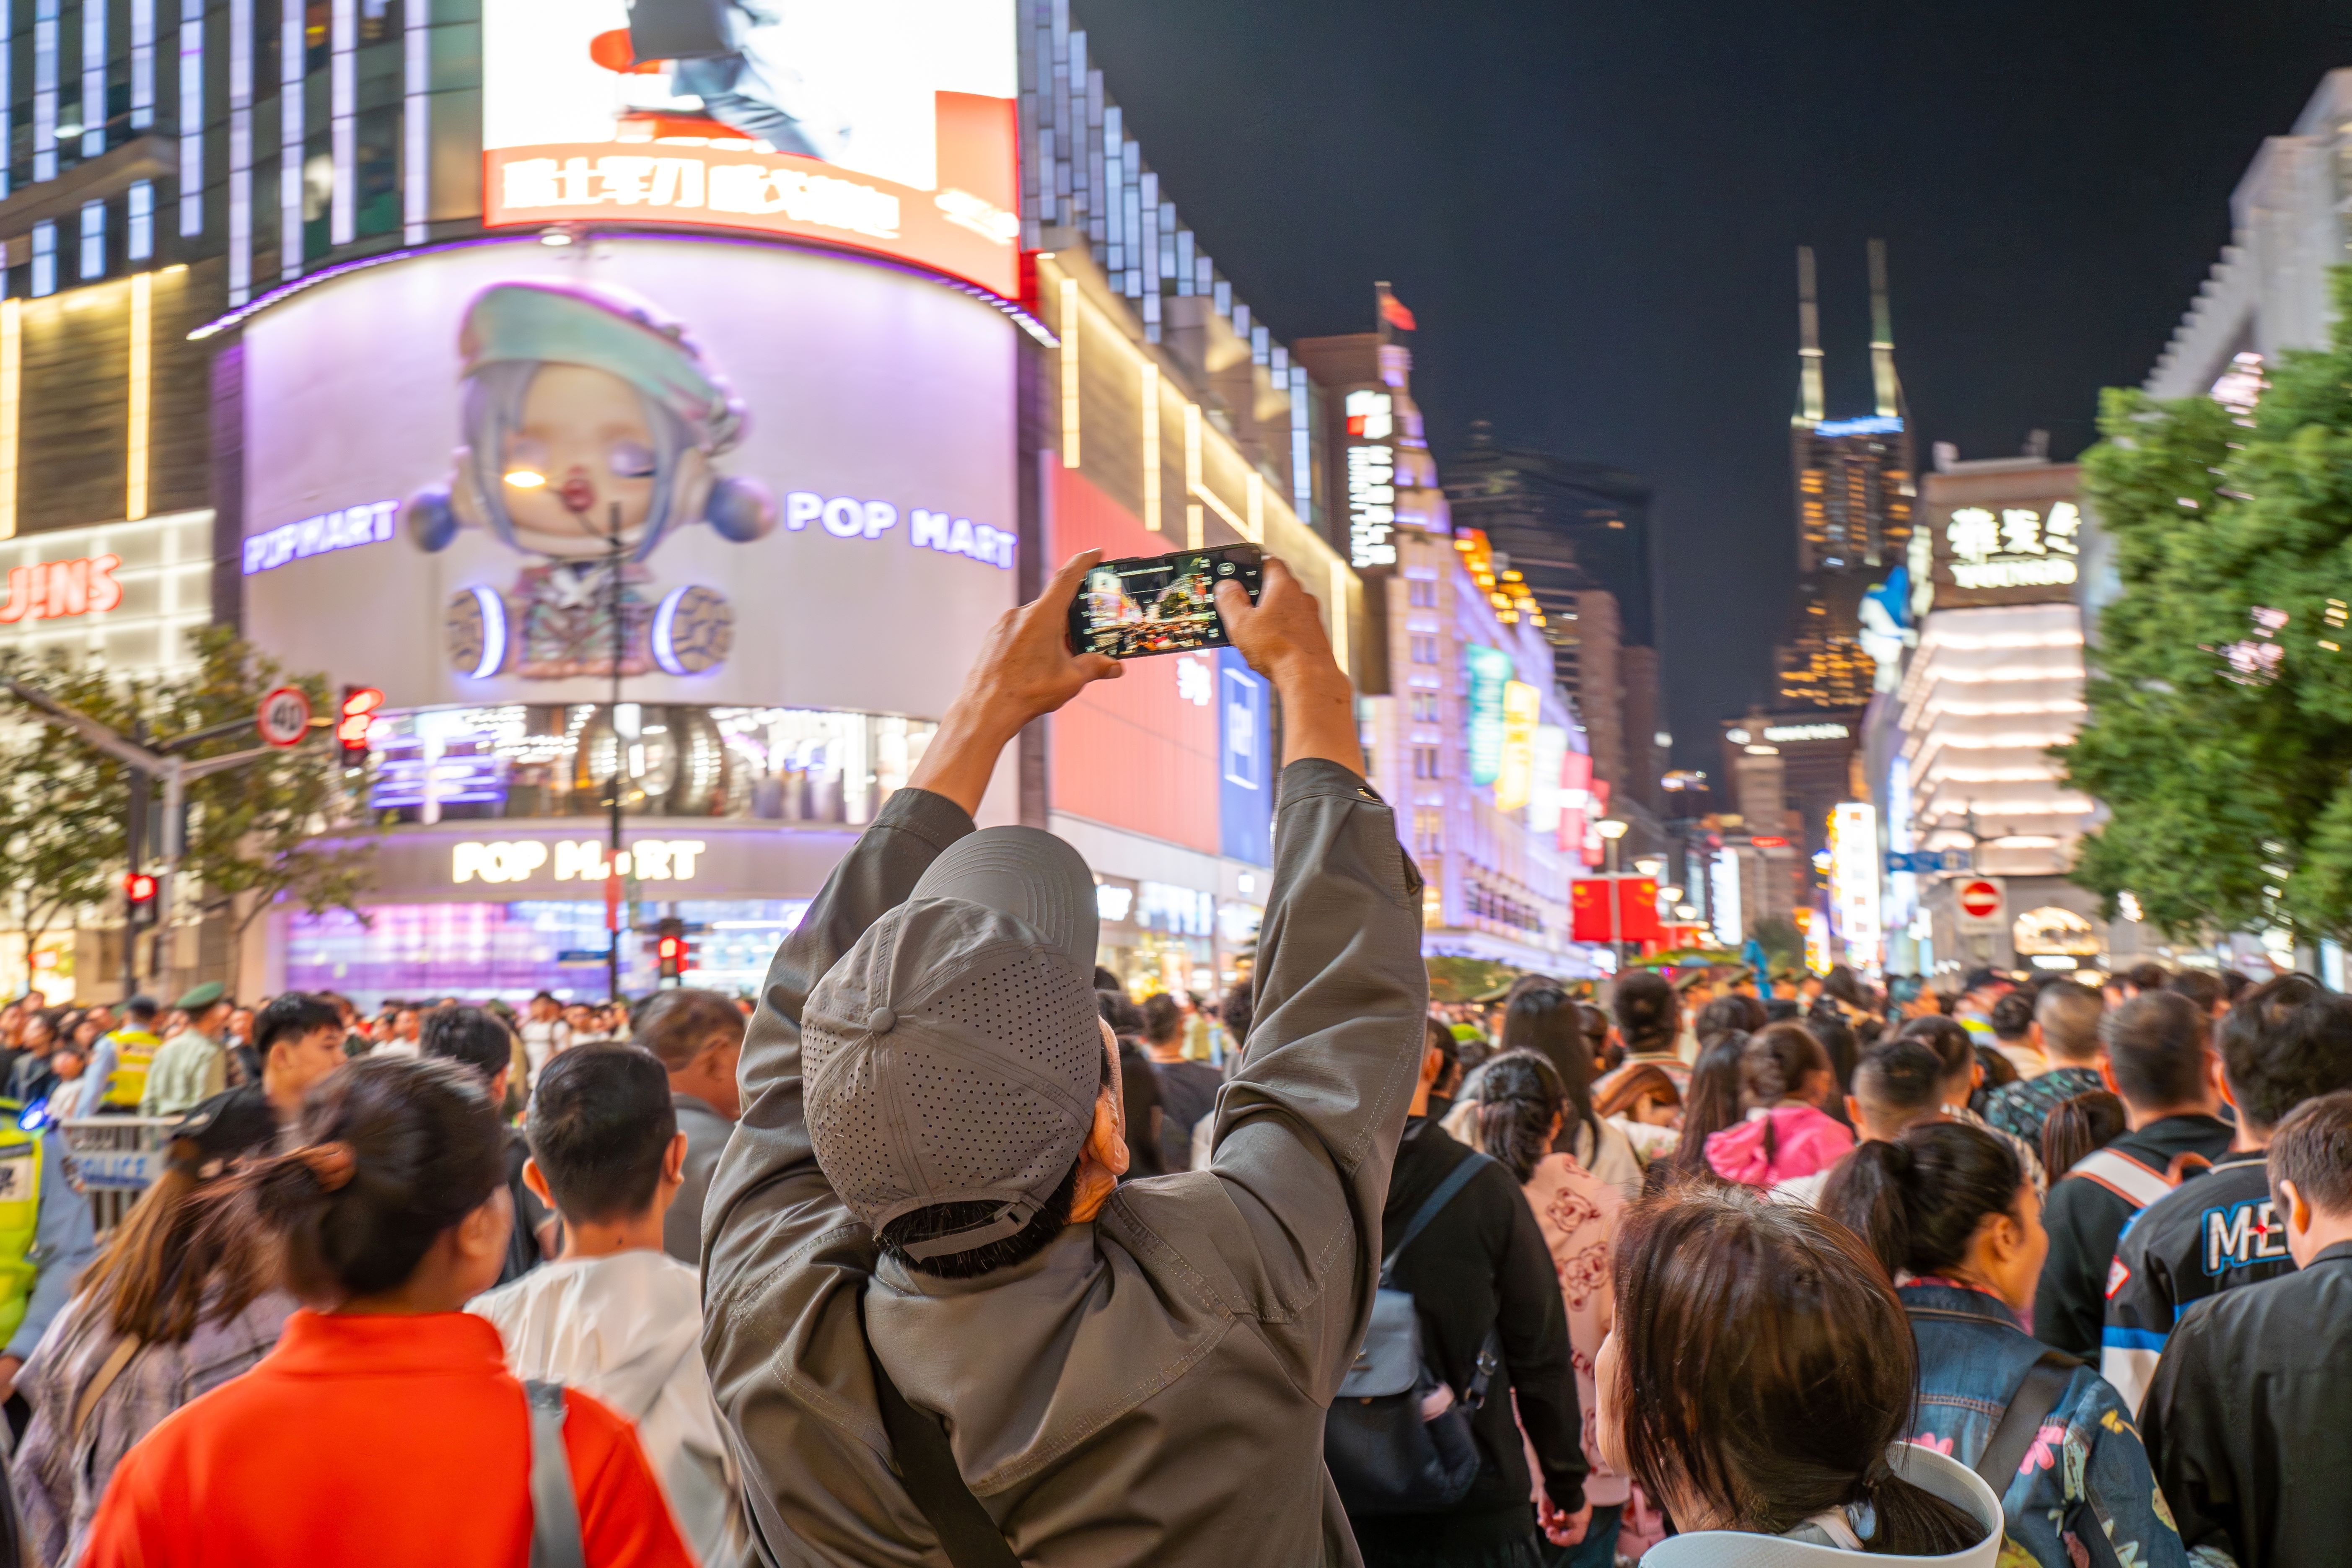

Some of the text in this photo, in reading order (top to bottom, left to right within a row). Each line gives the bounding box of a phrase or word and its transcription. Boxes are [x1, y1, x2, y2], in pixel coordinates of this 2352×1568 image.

[785, 491, 1018, 570] POP MART
[271, 701, 303, 731] 40
[453, 840, 548, 883] POP
